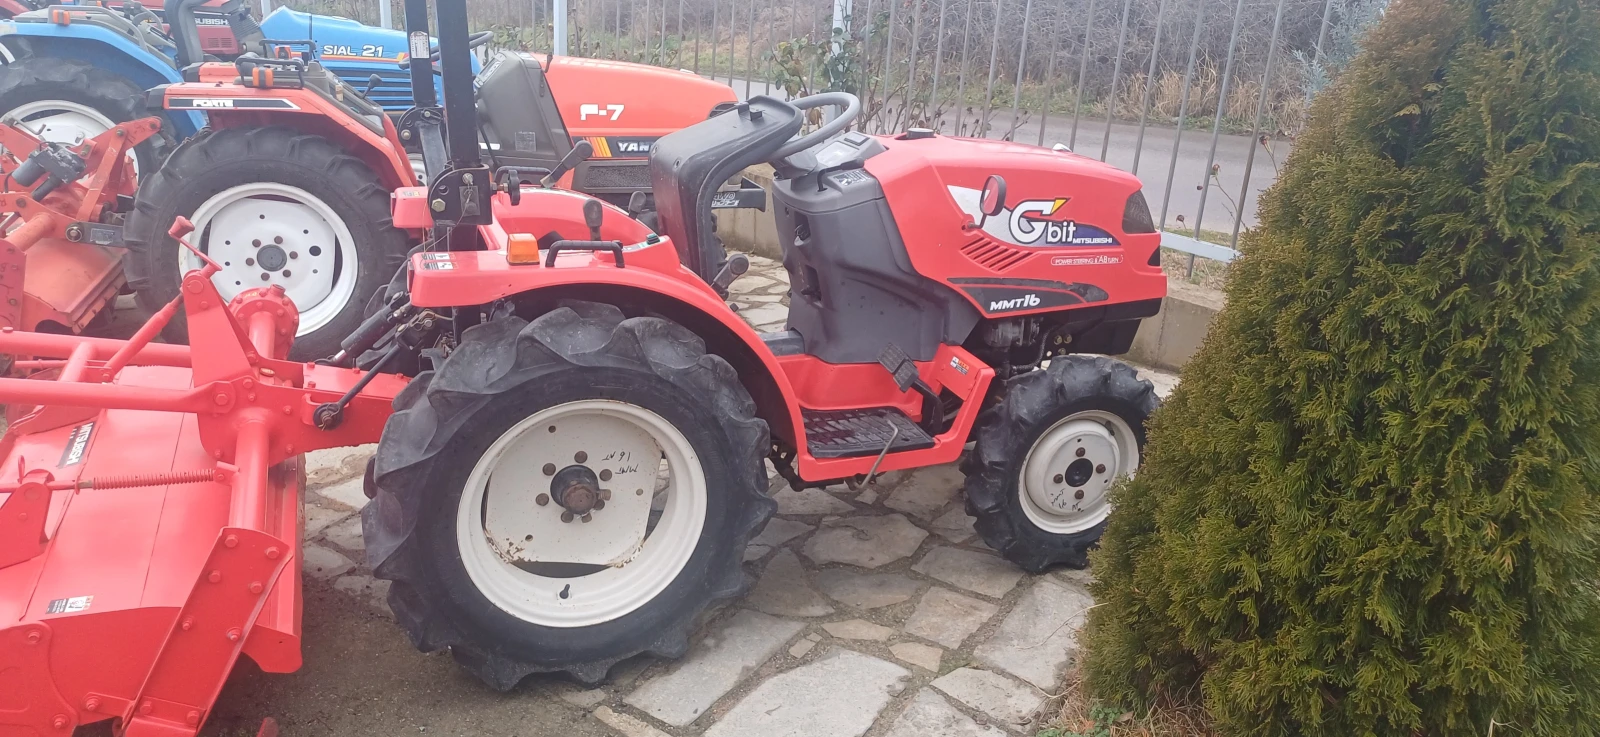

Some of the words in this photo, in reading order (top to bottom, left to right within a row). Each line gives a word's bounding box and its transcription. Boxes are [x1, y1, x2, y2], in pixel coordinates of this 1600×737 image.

[323, 45, 357, 56] SIAL
[361, 44, 384, 58] 21
[579, 103, 625, 121] F-7
[617, 141, 650, 152] YAN
[1008, 198, 1077, 244] Gbit
[1072, 237, 1113, 245] MITSUBISHI
[989, 293, 1041, 311] MMT16
[66, 421, 94, 465] MITSUBISHI
